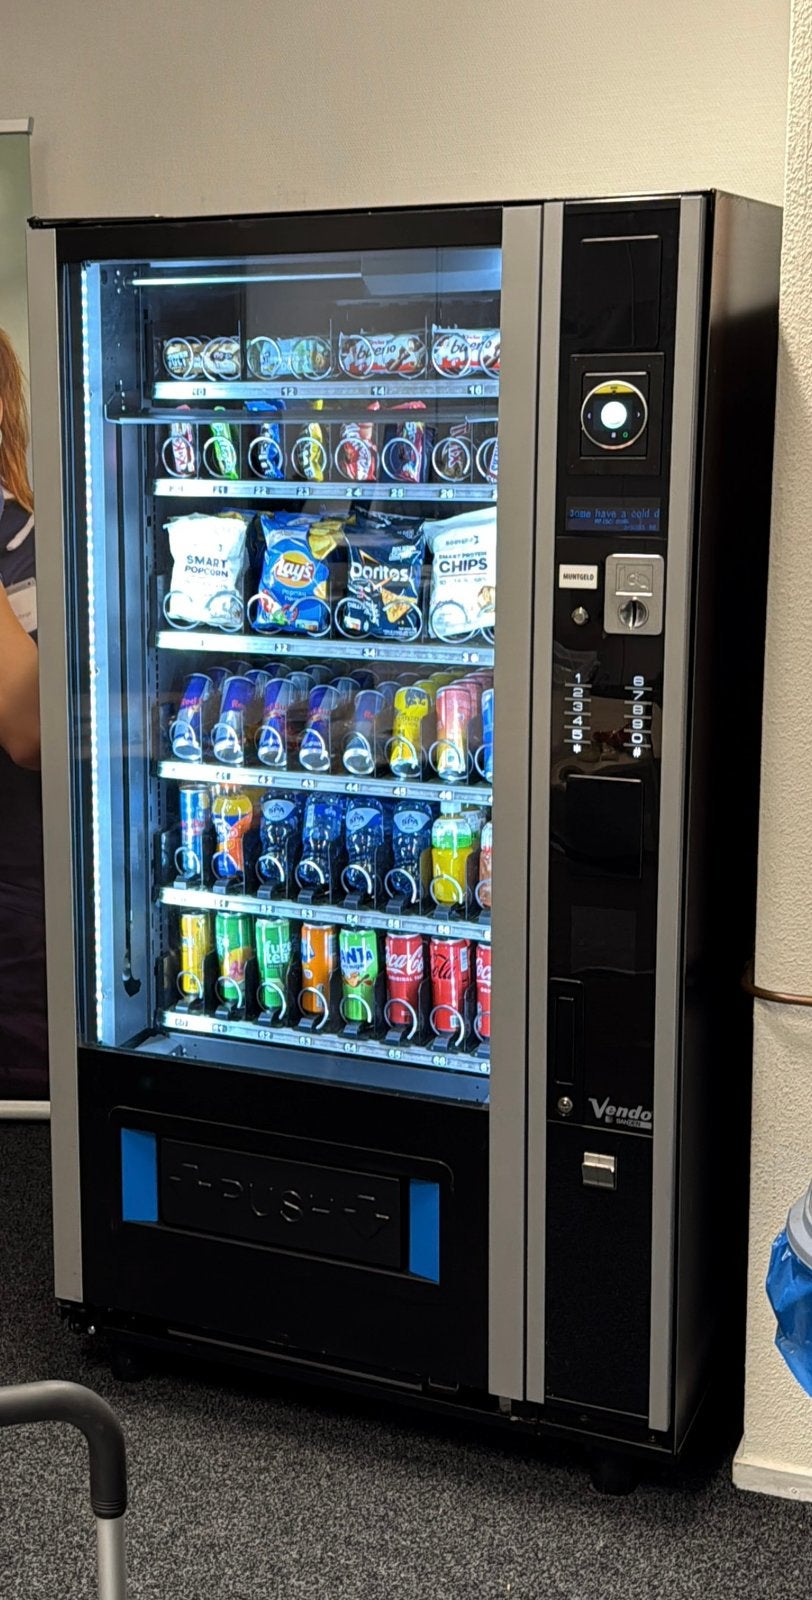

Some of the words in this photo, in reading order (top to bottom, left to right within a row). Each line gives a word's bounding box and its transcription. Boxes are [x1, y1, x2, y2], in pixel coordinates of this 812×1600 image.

[451, 338, 492, 354] bueno
[357, 344, 397, 359] bueno
[282, 387, 298, 396] 12
[372, 386, 386, 396] 14
[468, 385, 483, 395] 16
[254, 486, 270, 495] 22
[296, 487, 311, 496] 23
[346, 488, 361, 497] 24
[441, 489, 454, 498] 26
[595, 508, 616, 518] have
[187, 555, 228, 568] SMART
[439, 557, 488, 573] CHIPS
[184, 566, 229, 578] POPCORN
[275, 557, 314, 582] Lay's
[350, 561, 410, 582] Doritos
[563, 572, 595, 581] MUNTGELD
[362, 649, 376, 657] 34
[575, 673, 581, 683] 1
[573, 687, 583, 698] 2
[633, 690, 645, 700] 7
[573, 701, 583, 712] 3
[633, 704, 644, 715] 8
[572, 716, 583, 726] 4
[572, 729, 583, 740] 5
[631, 733, 643, 743] 0
[346, 783, 359, 792] 44
[341, 947, 373, 964] ANTA
[259, 1030, 271, 1039] 62
[299, 1037, 311, 1046] 63
[345, 1043, 356, 1053] 64
[389, 1050, 400, 1059] 65
[433, 1056, 446, 1066] 66
[588, 1096, 652, 1121] Vendo
